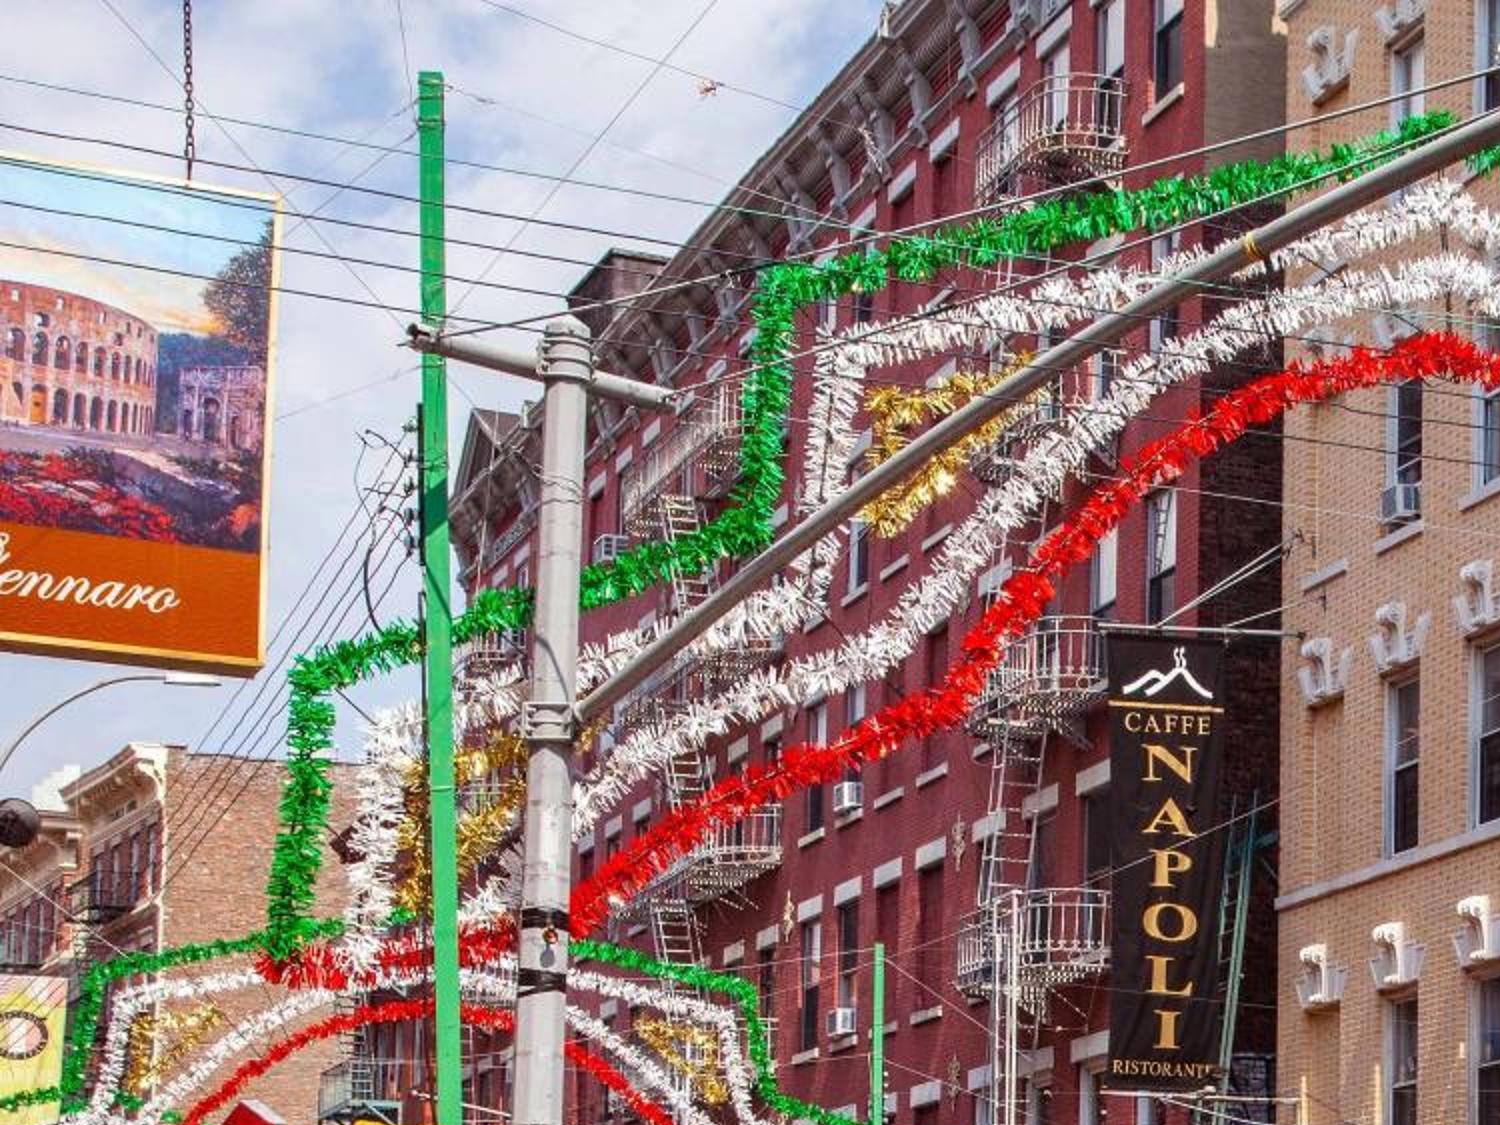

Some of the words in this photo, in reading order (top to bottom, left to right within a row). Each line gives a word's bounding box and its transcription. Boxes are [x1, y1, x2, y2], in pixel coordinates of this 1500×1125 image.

[0, 568, 181, 613] ennaro
[1124, 712, 1211, 735] CAFFE
[1141, 743, 1198, 1049] NAPOLI
